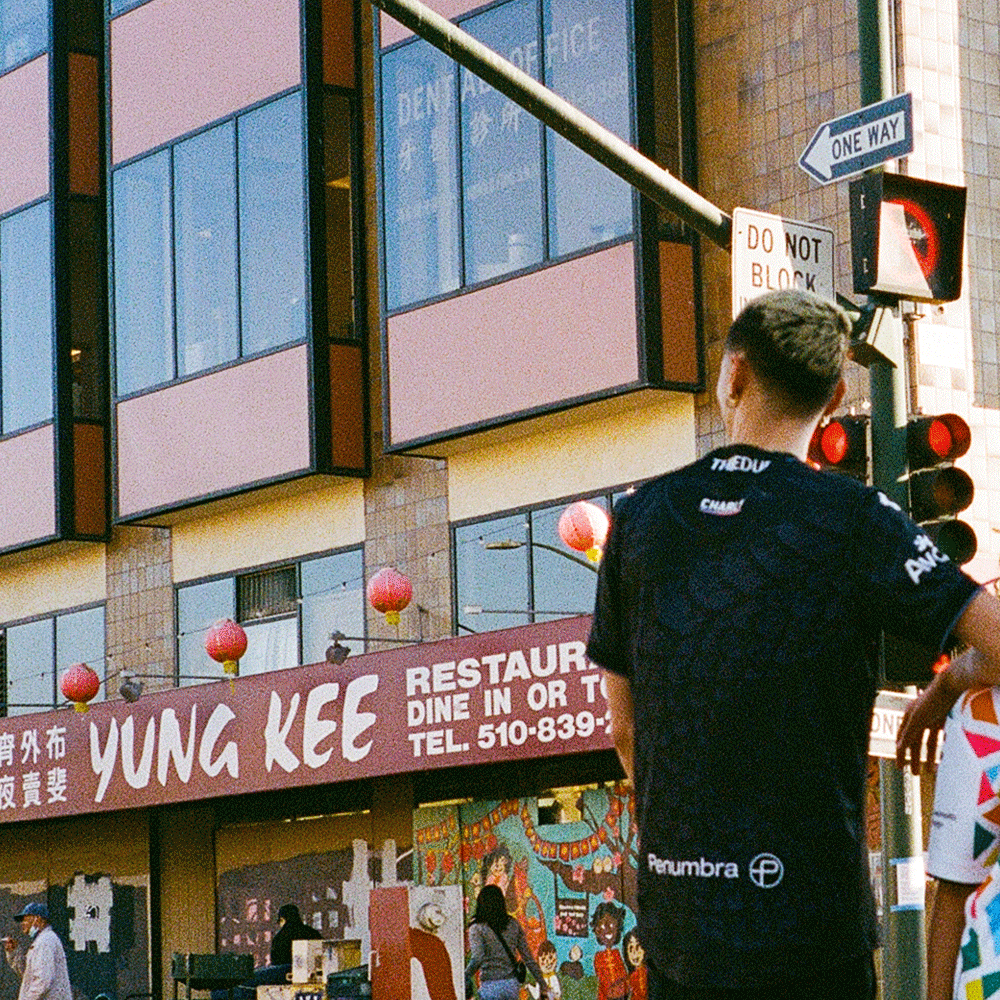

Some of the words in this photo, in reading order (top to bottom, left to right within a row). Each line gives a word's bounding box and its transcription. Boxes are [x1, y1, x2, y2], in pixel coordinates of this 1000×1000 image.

[832, 131, 862, 160] ONE
[867, 117, 899, 148] WAY
[748, 225, 774, 254] DO
[785, 232, 822, 264] NOT
[752, 262, 816, 293] BLOCK
[406, 641, 599, 697] RESTAUR
[407, 692, 470, 737] DINE
[484, 687, 512, 717] IN
[527, 680, 568, 711] OR
[89, 702, 239, 804] YUNG
[264, 673, 380, 775] KEE
[408, 728, 470, 758] TEL.
[648, 853, 740, 879] Penumbra
